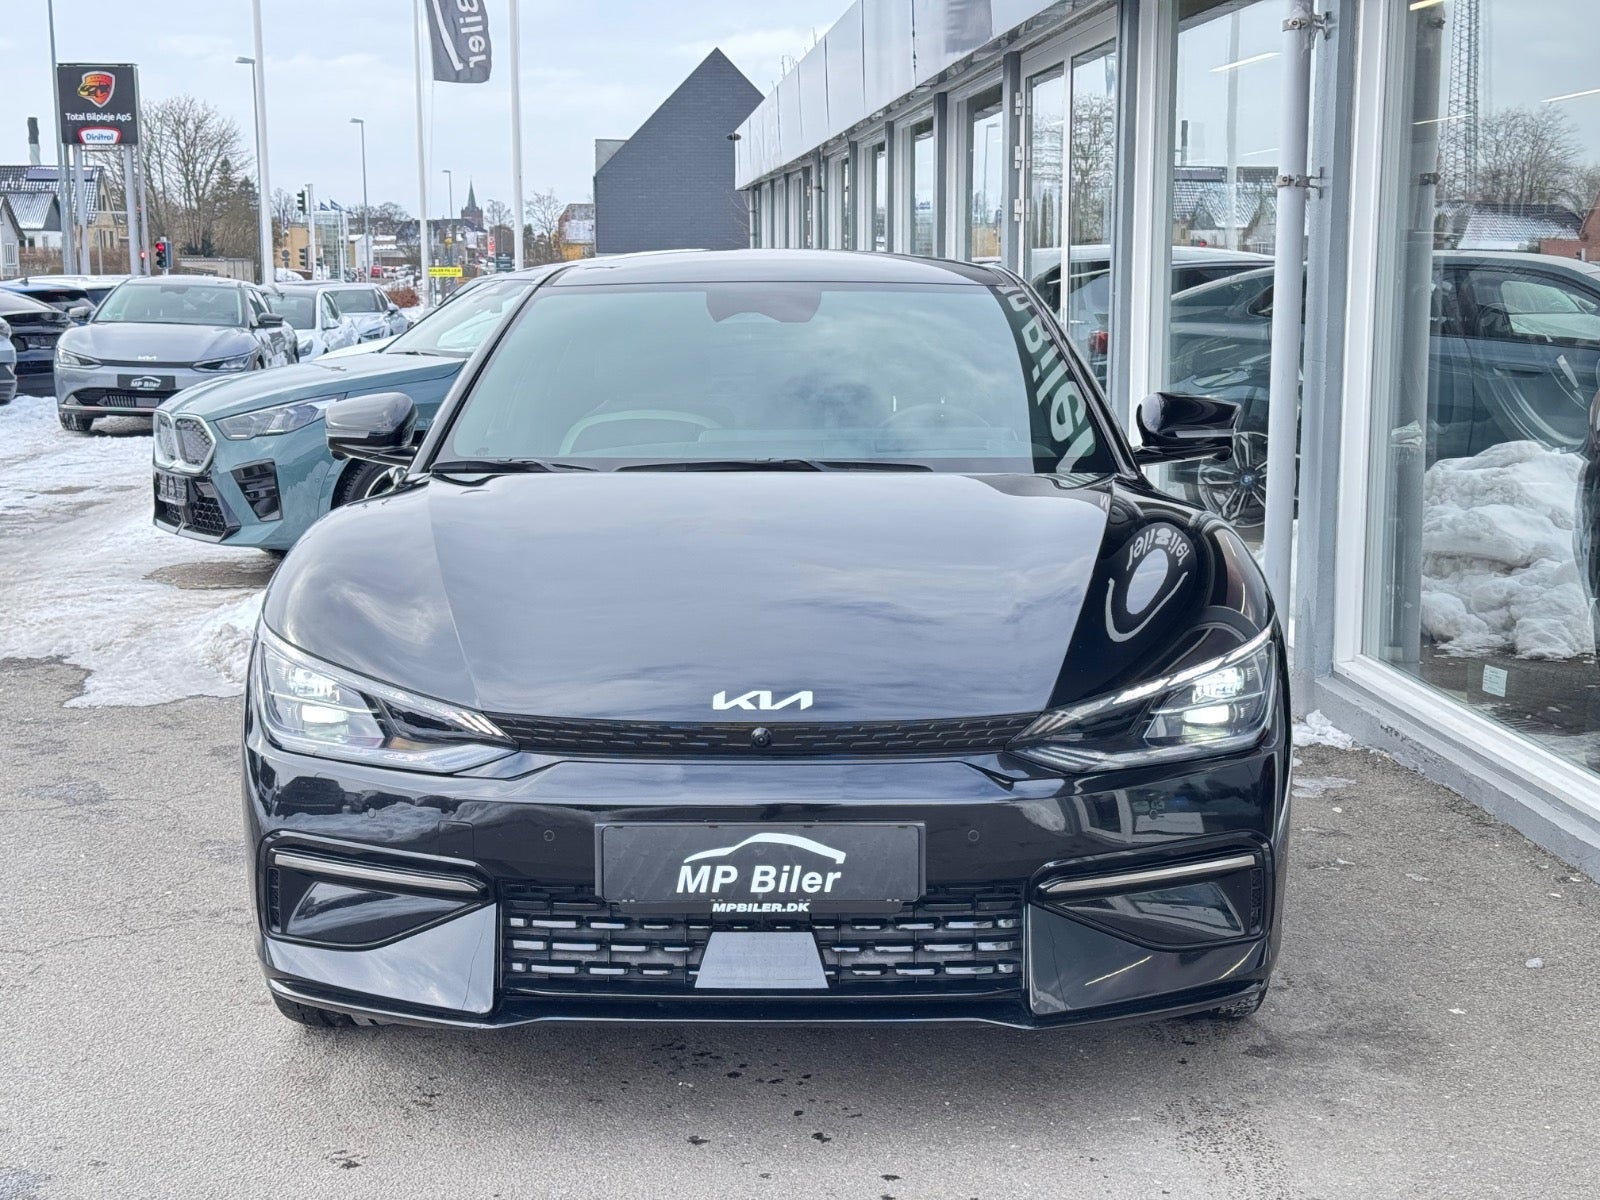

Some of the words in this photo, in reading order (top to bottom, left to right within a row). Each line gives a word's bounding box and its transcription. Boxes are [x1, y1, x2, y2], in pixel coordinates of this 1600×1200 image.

[65, 113, 85, 121] Total
[86, 112, 115, 122] Bilpleje
[116, 113, 132, 122] ApS
[712, 690, 813, 710] KIA
[676, 865, 738, 893] MP
[750, 865, 841, 893] Biler
[712, 903, 811, 913] MPBILER.DK
